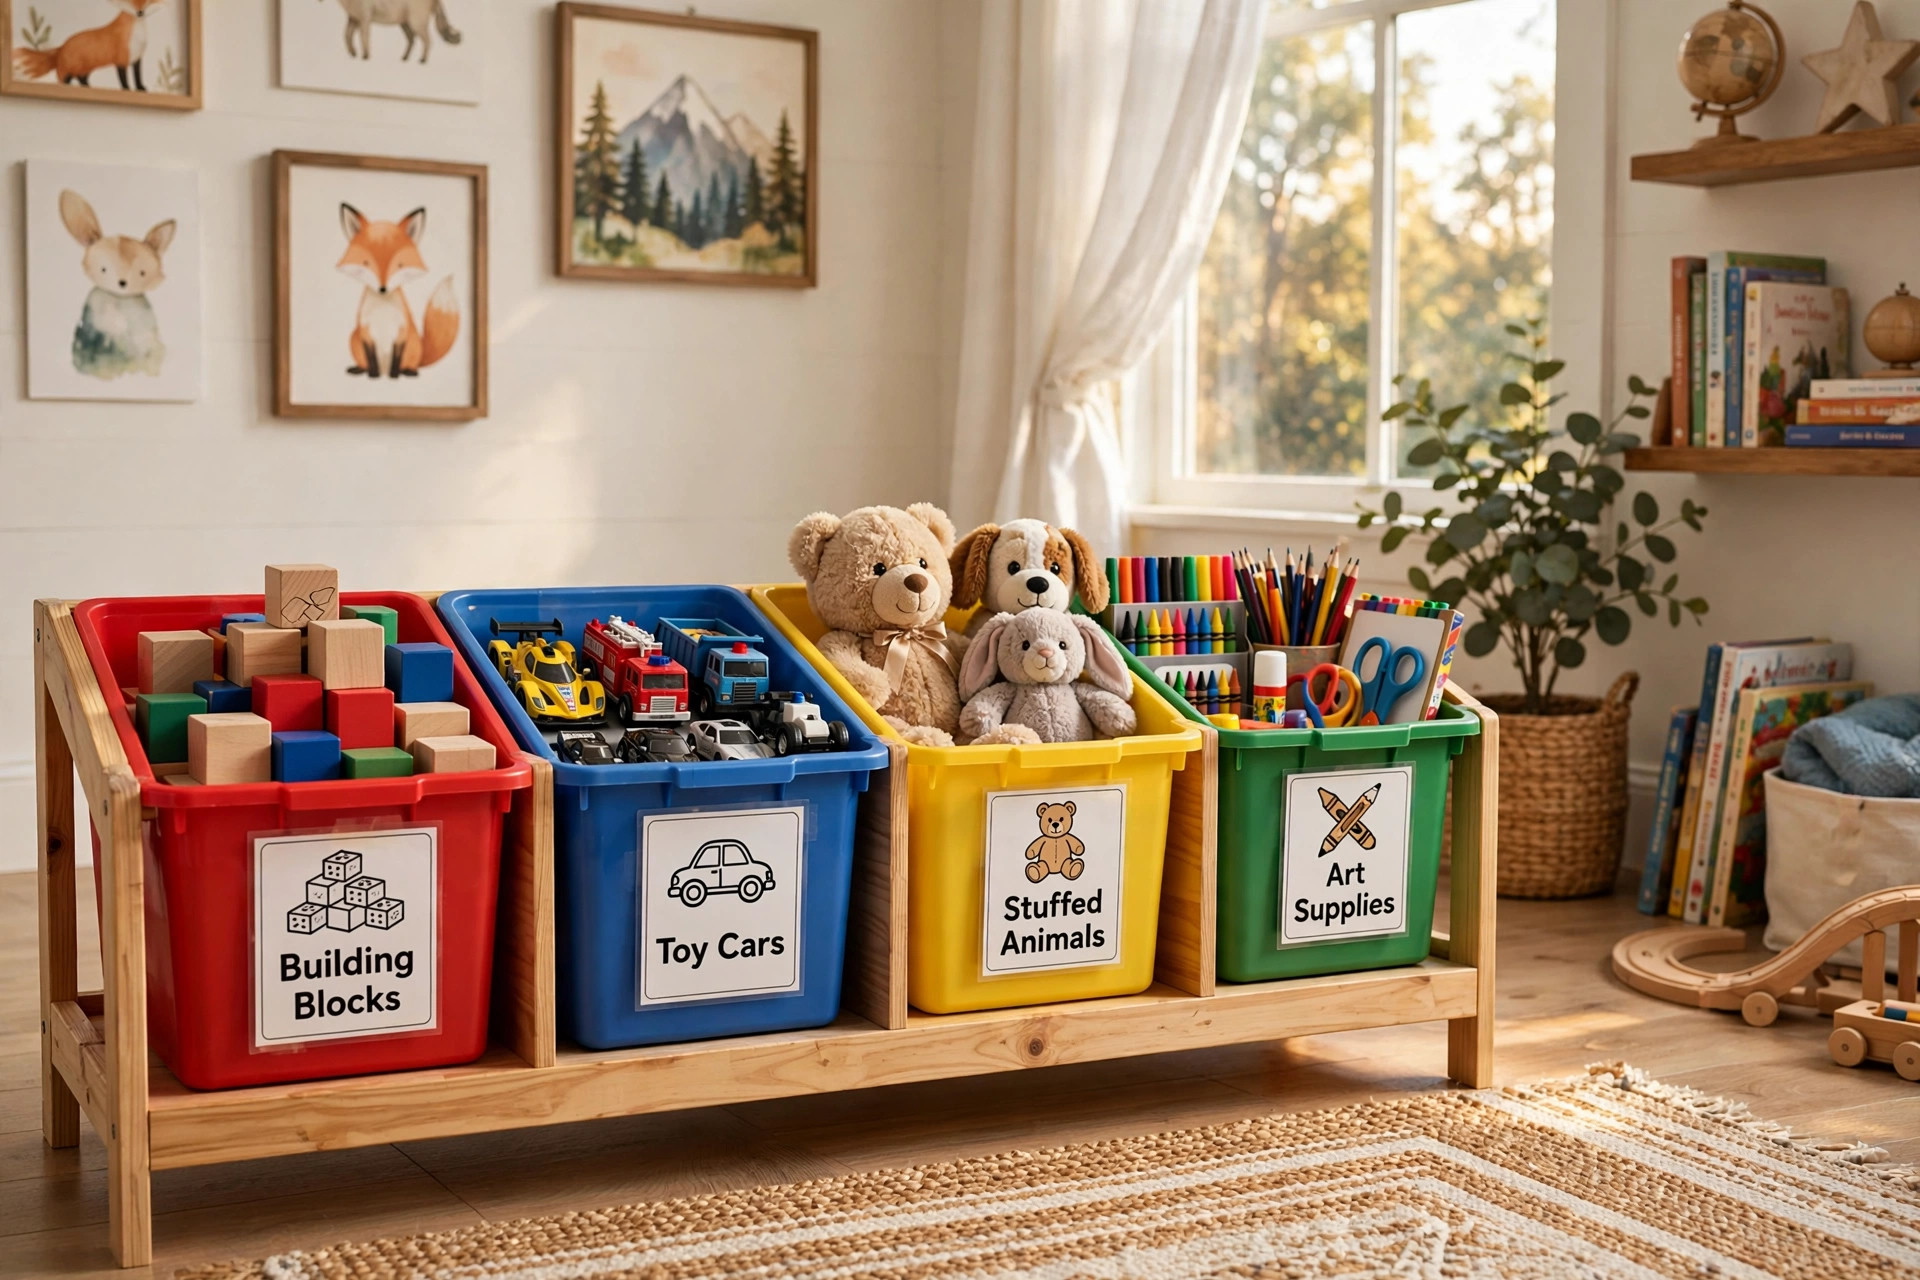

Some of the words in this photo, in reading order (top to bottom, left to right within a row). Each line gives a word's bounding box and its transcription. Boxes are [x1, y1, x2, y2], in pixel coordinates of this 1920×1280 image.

[1326, 862, 1365, 887] Art
[1004, 888, 1102, 921] Stuffed
[1294, 892, 1395, 926] Supplies
[656, 936, 708, 969] Toy
[718, 932, 785, 959] Cars
[1000, 923, 1105, 955] Animals
[280, 946, 413, 981] Building
[295, 985, 401, 1020] Blocks
